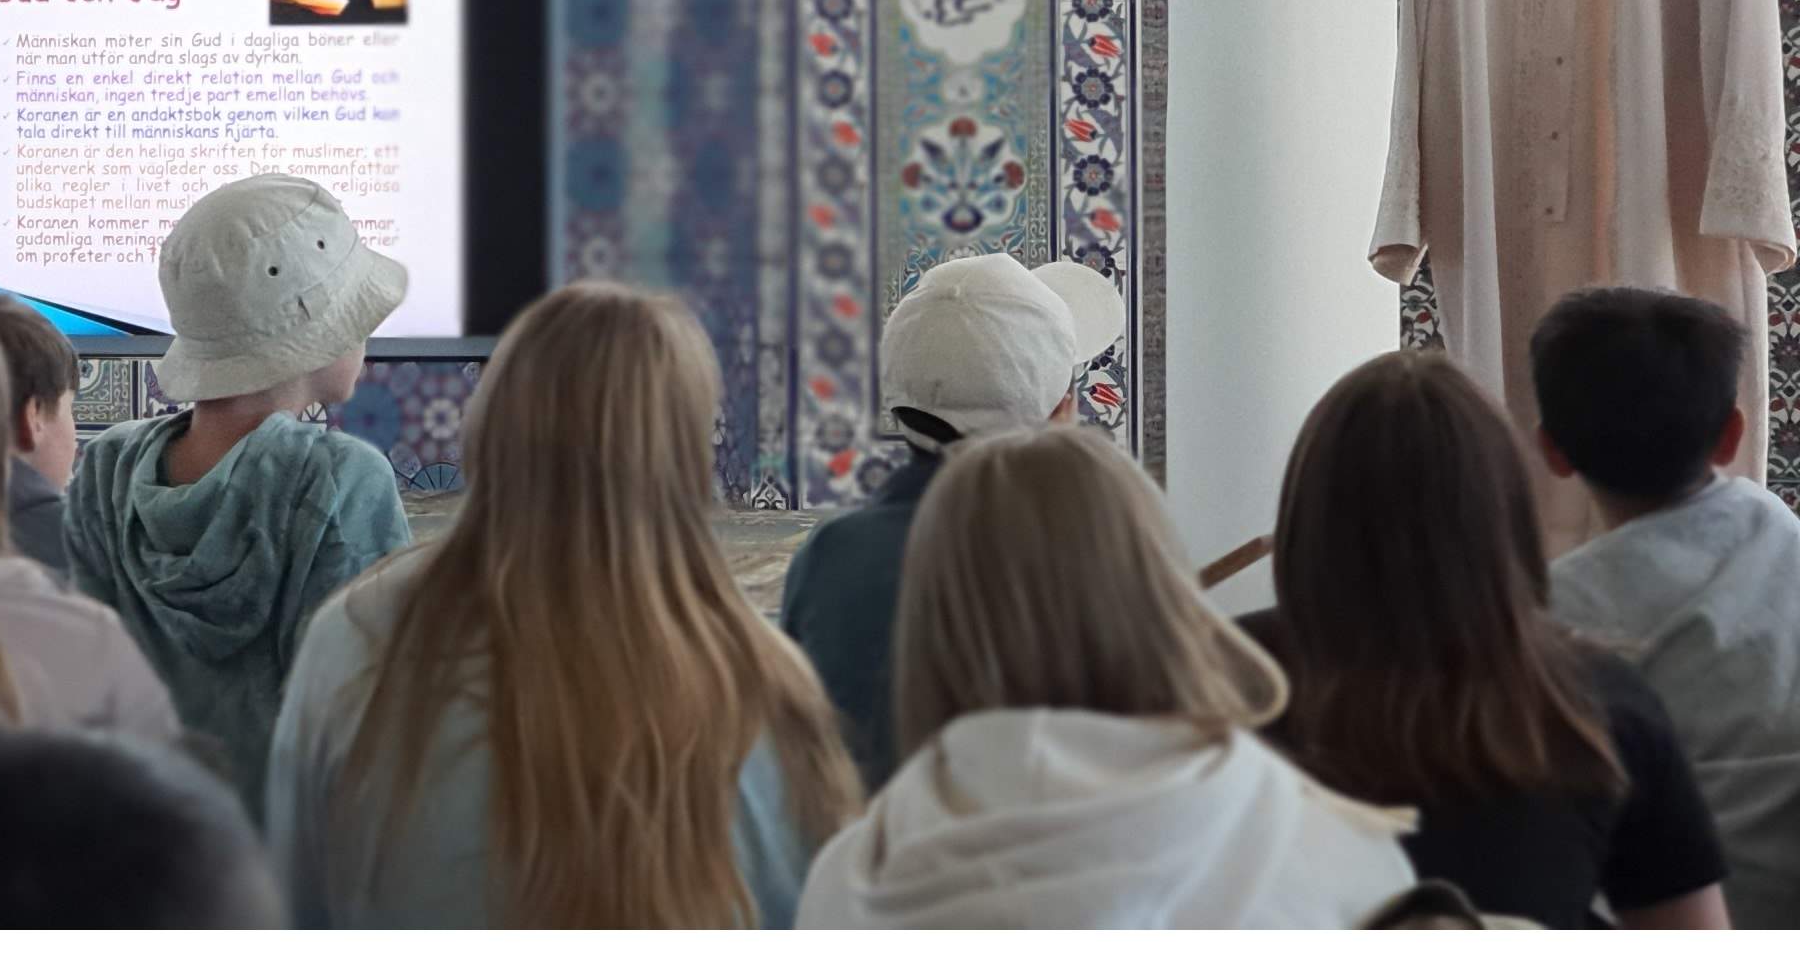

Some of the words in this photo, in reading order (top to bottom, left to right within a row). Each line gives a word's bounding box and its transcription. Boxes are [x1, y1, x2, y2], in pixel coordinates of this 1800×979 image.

[16, 33, 97, 48] Människan
[161, 33, 183, 48] sin
[191, 32, 222, 47] Gud
[244, 32, 300, 51] dagliga
[308, 32, 354, 47] böner
[16, 51, 42, 65] när
[46, 54, 77, 65] man
[129, 50, 174, 65] andra
[179, 49, 217, 68] slags
[222, 53, 240, 64] av
[16, 70, 57, 85] Finns
[65, 73, 84, 85] en
[93, 70, 133, 85] enkel
[143, 70, 192, 85] direkt
[201, 70, 263, 85] relation
[272, 70, 322, 85] mellan
[331, 69, 363, 84] Gud
[104, 88, 145, 106] ingen
[151, 87, 202, 106] tredje
[207, 88, 240, 104] part
[246, 87, 305, 102] emellan
[16, 107, 79, 122] Koranen
[84, 107, 104, 122] är
[107, 111, 126, 122] en
[131, 107, 222, 122] andaktsbok
[227, 110, 277, 126] genom
[284, 107, 329, 121] vilken
[335, 107, 366, 121] Gud
[16, 125, 46, 139] tala
[51, 125, 99, 139] direkt
[105, 125, 126, 139] till
[132, 124, 219, 139] människans
[16, 144, 78, 159] Koranen
[84, 144, 100, 159] är
[106, 144, 134, 159] den
[139, 143, 185, 162] heliga
[191, 143, 256, 159] skriften
[262, 143, 287, 159] för
[374, 145, 400, 159] ett
[16, 161, 95, 176] underverk
[102, 165, 131, 176] som
[139, 160, 205, 179] vägleder
[250, 161, 280, 175] Den
[288, 160, 400, 175] sammanfattar
[16, 178, 52, 192] olika
[62, 178, 110, 196] regler
[136, 178, 171, 192] livet
[181, 178, 208, 192] och
[16, 195, 97, 212] budskapet
[102, 195, 151, 209] mellan
[16, 215, 79, 230] Koranen
[88, 215, 149, 230] kommer
[15, 232, 93, 250] gudomliga
[102, 233, 166, 250] meninga
[360, 233, 400, 247] orier
[16, 252, 38, 263] om
[43, 248, 112, 266] profeter
[116, 248, 144, 263] och
